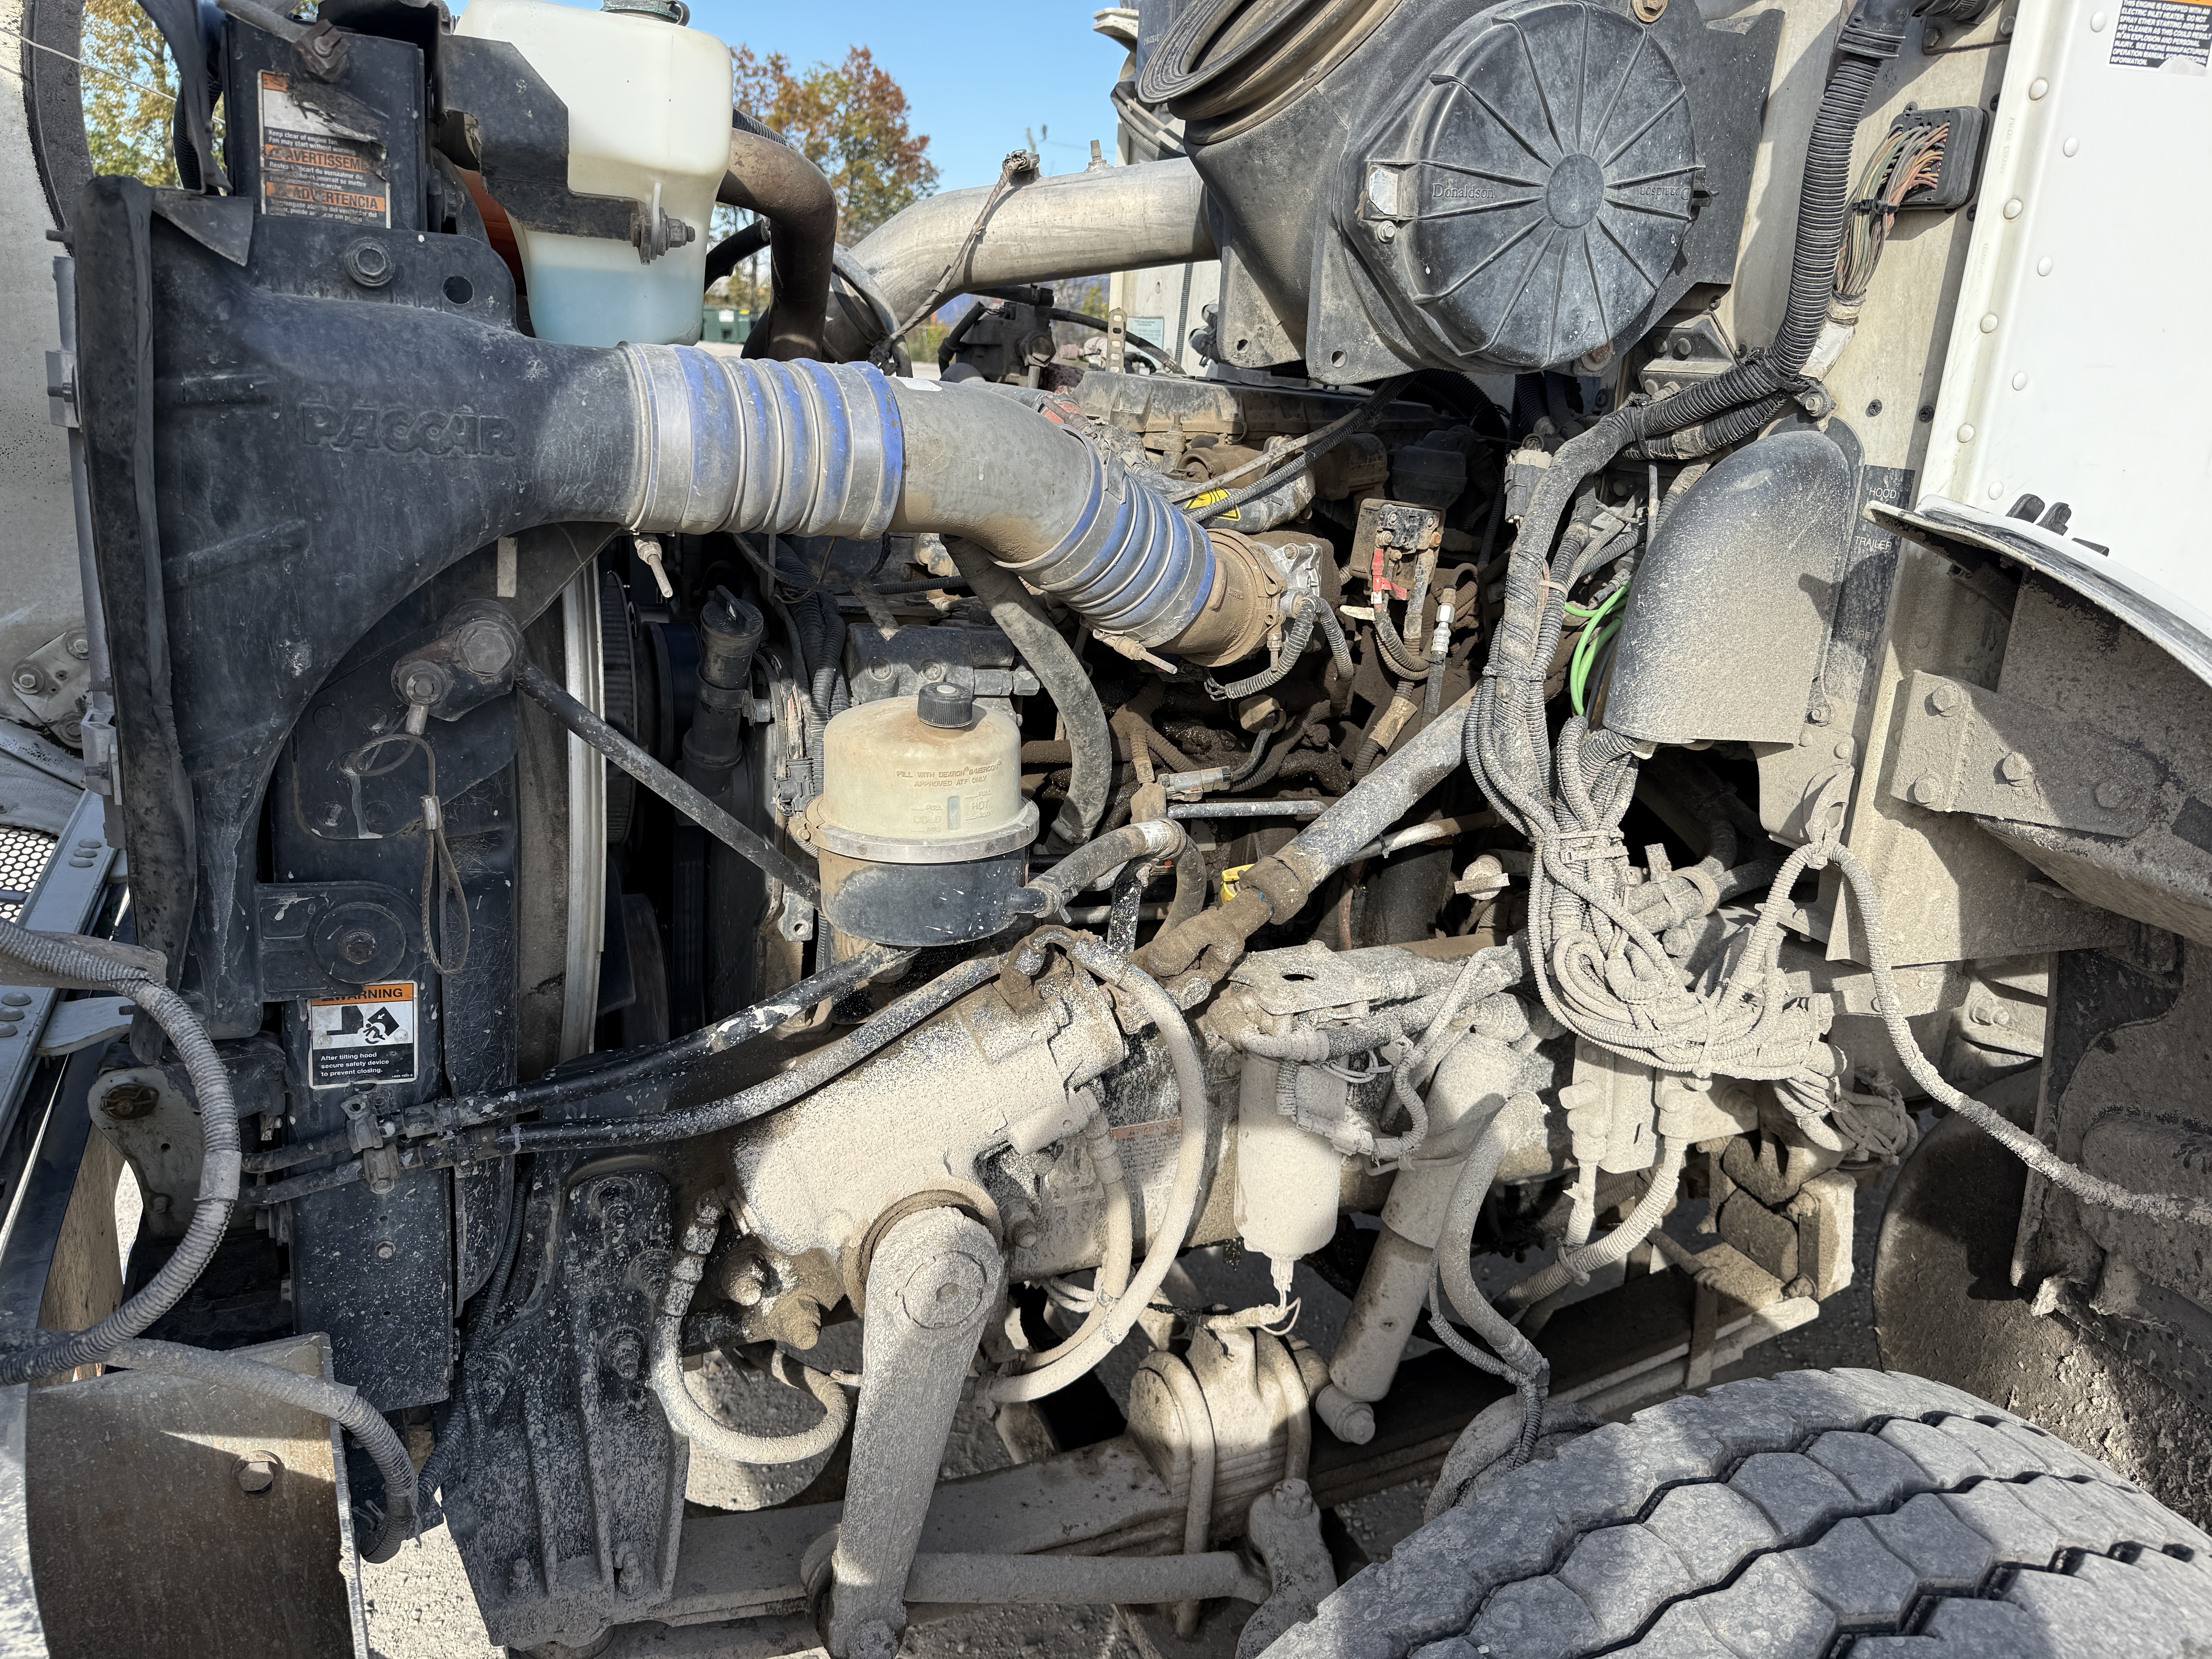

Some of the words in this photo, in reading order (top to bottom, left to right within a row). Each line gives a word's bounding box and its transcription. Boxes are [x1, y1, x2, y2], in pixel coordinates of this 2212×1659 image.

[2121, 7, 2147, 16] ELECTRIC
[2136, 0, 2156, 9] ENGINE
[2162, 3, 2188, 12] EQUIPPED
[2119, 15, 2138, 24] SPRAY
[2138, 17, 2156, 26] ETHER
[2156, 19, 2182, 29] STARTING
[2128, 25, 2152, 34] CLEANER
[2173, 29, 2192, 38] COULD
[2191, 31, 2212, 40] RESULT
[2131, 34, 2161, 43] EXPLOSION
[2172, 38, 2200, 47] PERSONAL
[2112, 48, 2143, 57] OPERATION
[2143, 51, 2165, 59] MANUAL
[268, 129, 283, 137] Keep
[307, 136, 327, 144] engine
[324, 170, 354, 179] ventilateur
[1432, 183, 1494, 198] Donaldson
[1639, 186, 1691, 200] Donaldson
[298, 401, 517, 457] PACCAR
[1869, 486, 1897, 499] HOOD
[972, 775, 987, 783] ONLY
[972, 800, 989, 811] HOT
